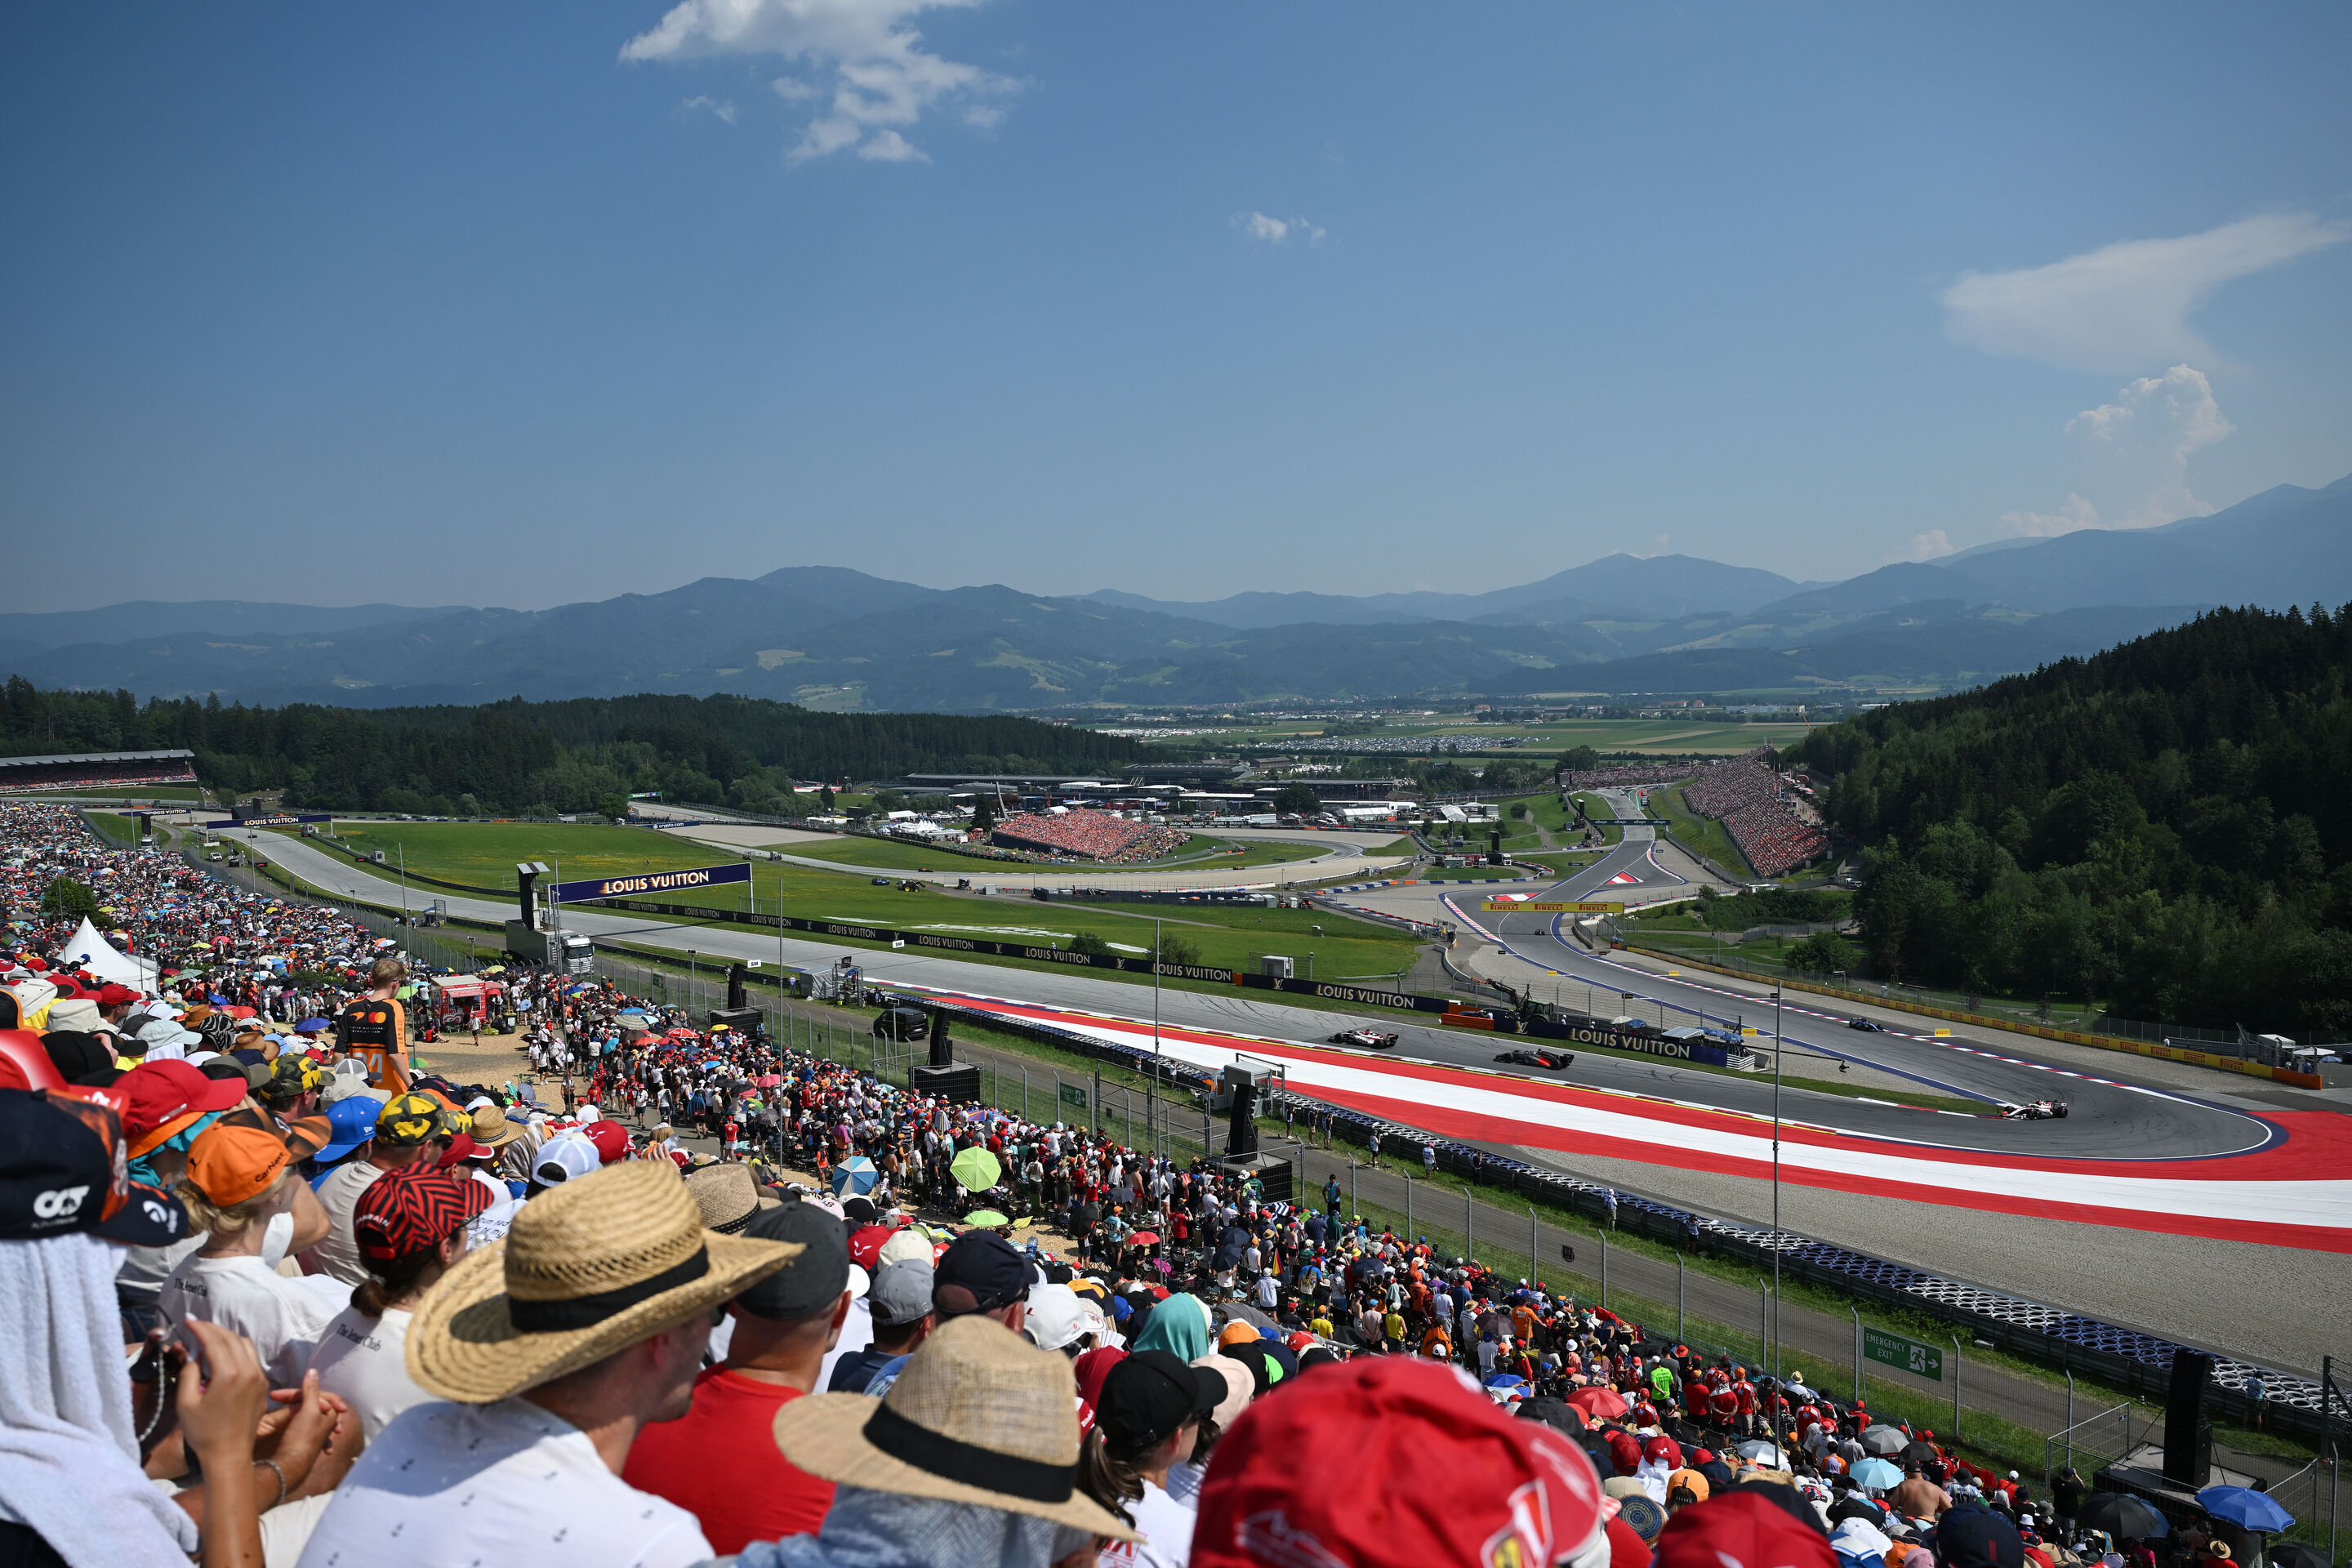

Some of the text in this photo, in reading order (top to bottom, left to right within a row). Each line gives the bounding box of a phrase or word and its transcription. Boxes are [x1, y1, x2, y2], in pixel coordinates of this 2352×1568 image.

[606, 871, 709, 894] LOUIS VUITTON
[640, 903, 658, 912] VUITTON
[684, 907, 720, 919] LOUIS VUITTON
[751, 915, 791, 927] LOUIS VUITON
[828, 924, 876, 938] LOUIS VUITTON
[920, 935, 974, 951] LOUIS VUITTON
[1026, 947, 1090, 964] LOUIS VUITTON
[1153, 963, 1231, 981] LOUIS VUITTON
[1318, 984, 1414, 1009] LOUIS VUITTON
[1993, 1019, 2006, 1028] PIRELLI
[2015, 1023, 2030, 1032] PIRELLI
[2039, 1027, 2055, 1038] PIRELLI
[2065, 1032, 2081, 1043] PIRELLI
[1571, 1027, 1690, 1058] LOUIS VUITTON
[2091, 1036, 2109, 1047] PIRELLI
[2120, 1041, 2139, 1052] PIRELLI
[2151, 1046, 2171, 1058] PIRELLI
[2184, 1051, 2206, 1063] PIRELLI
[2220, 1058, 2244, 1071] PIRELLI
[363, 1335, 381, 1352] Club
[1866, 1332, 1905, 1352] EMERGENCY
[1878, 1348, 1893, 1360] EXIT
